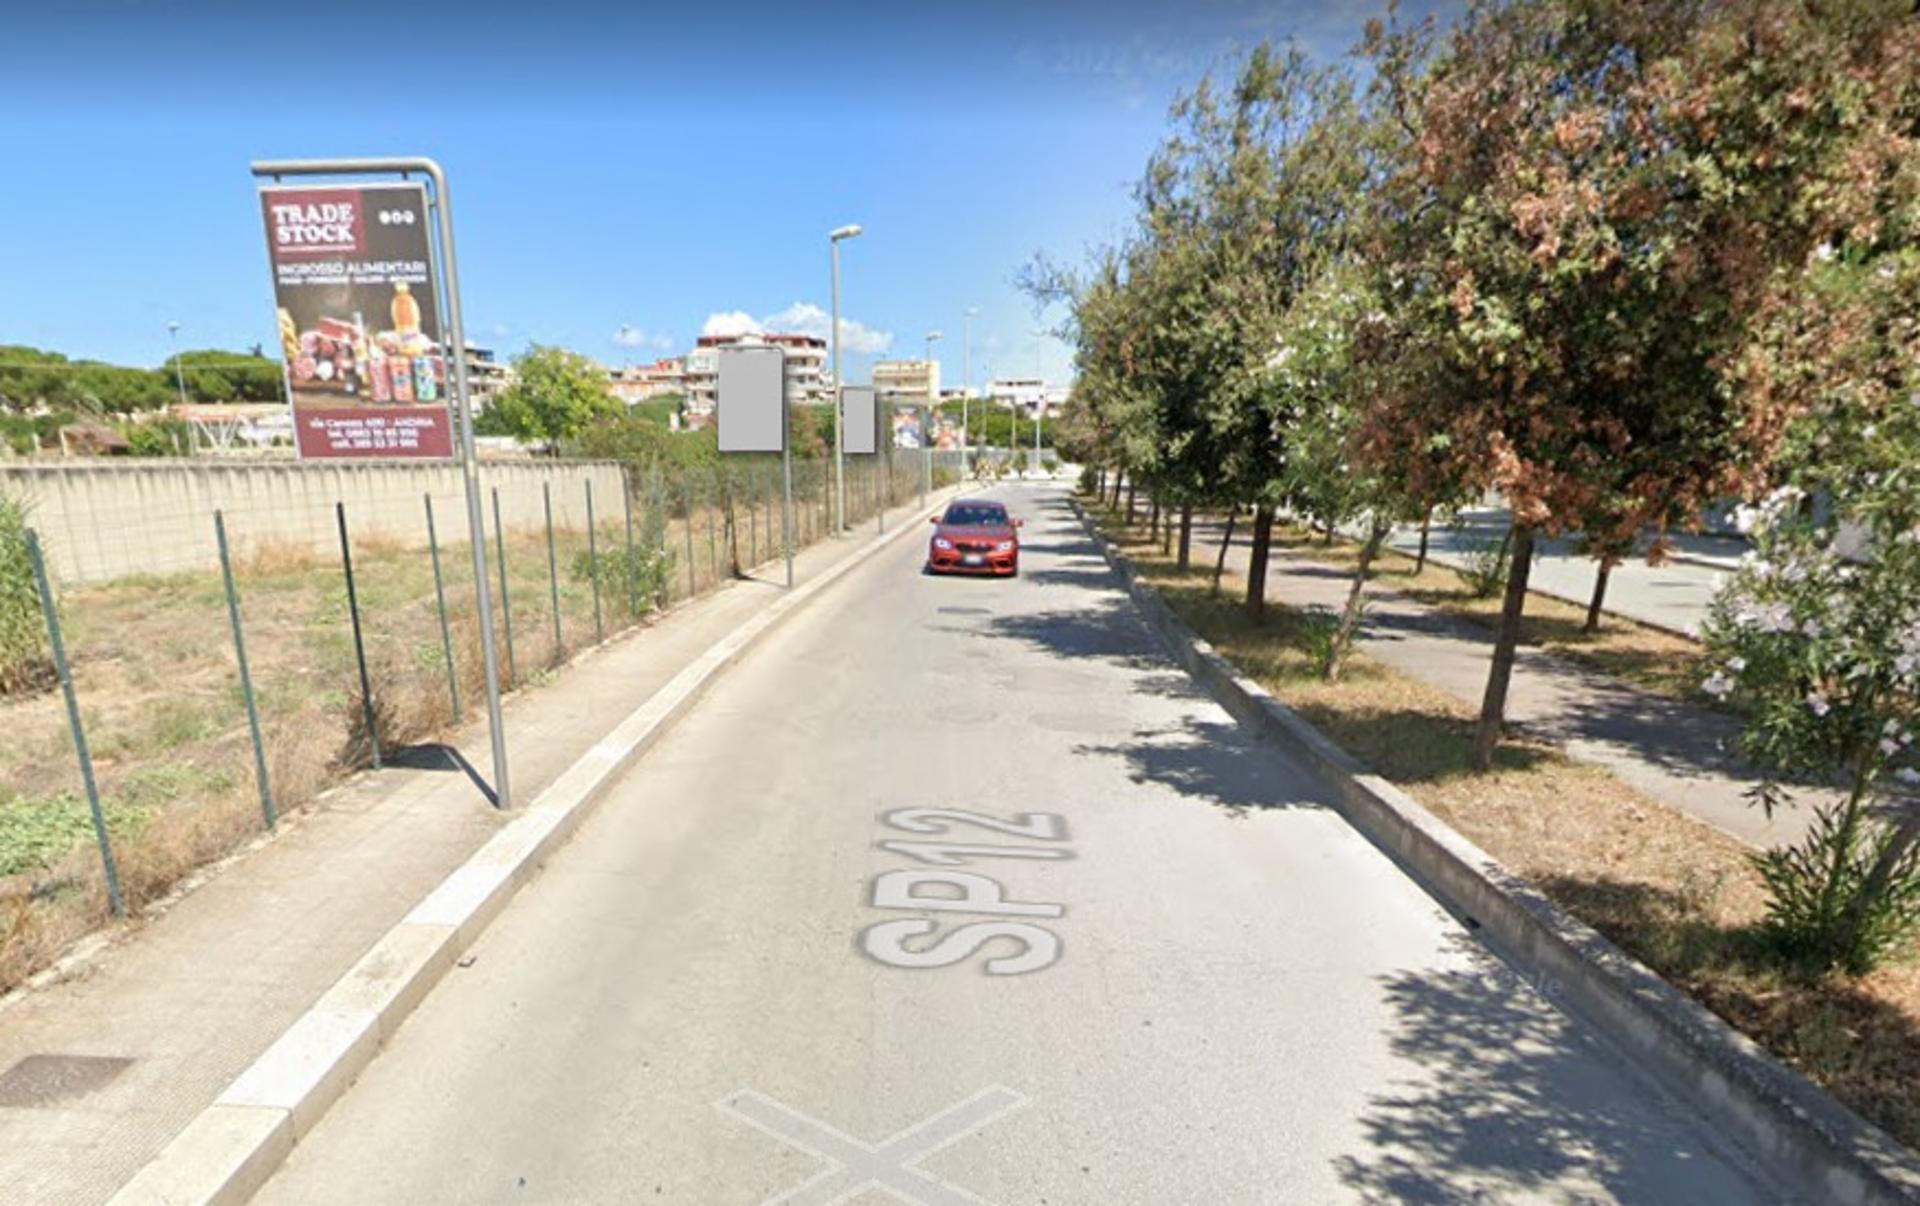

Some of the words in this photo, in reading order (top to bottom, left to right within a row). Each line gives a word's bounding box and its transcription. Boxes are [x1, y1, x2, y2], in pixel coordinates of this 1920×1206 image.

[272, 203, 354, 224] TRADE
[277, 224, 355, 244] STOCK
[277, 262, 344, 275] INGROSSO
[347, 261, 427, 274] ALIMENTARI
